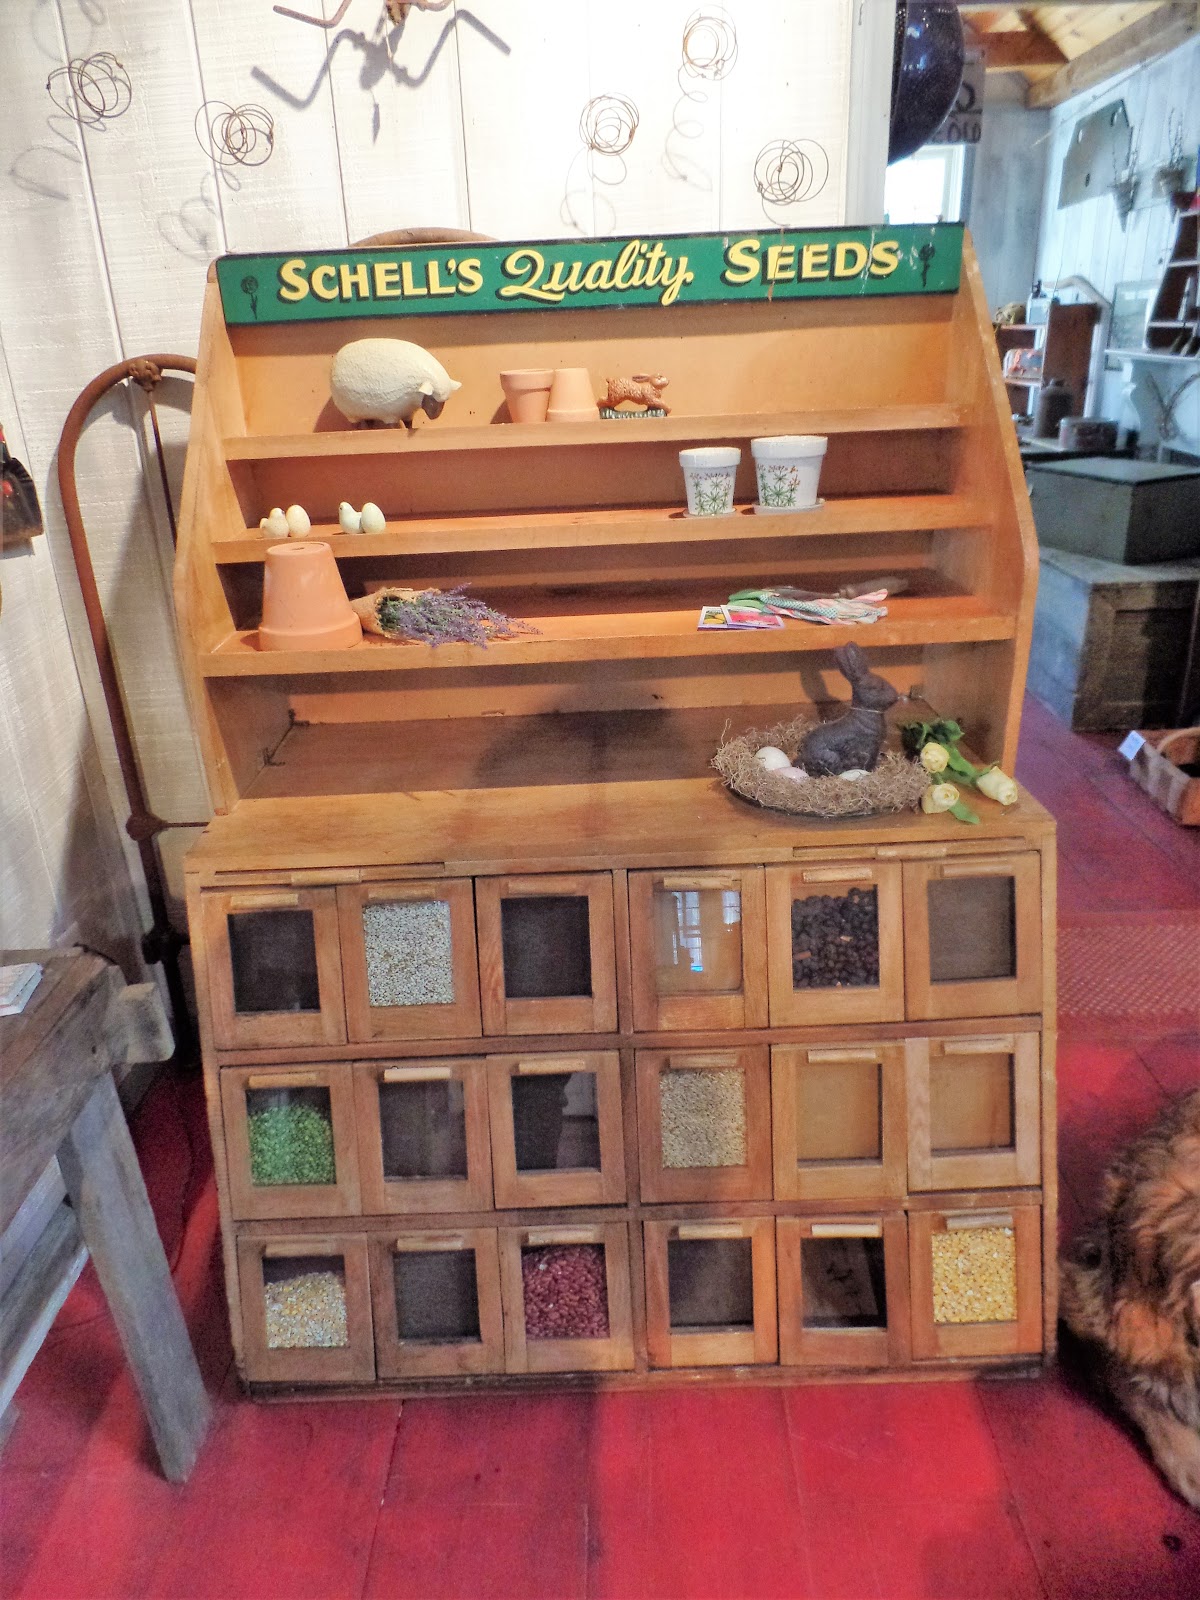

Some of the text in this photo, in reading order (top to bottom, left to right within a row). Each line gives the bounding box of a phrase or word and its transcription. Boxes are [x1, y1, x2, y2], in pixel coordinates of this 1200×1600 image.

[277, 239, 899, 306] SCHELL'S Quality SEEDS
